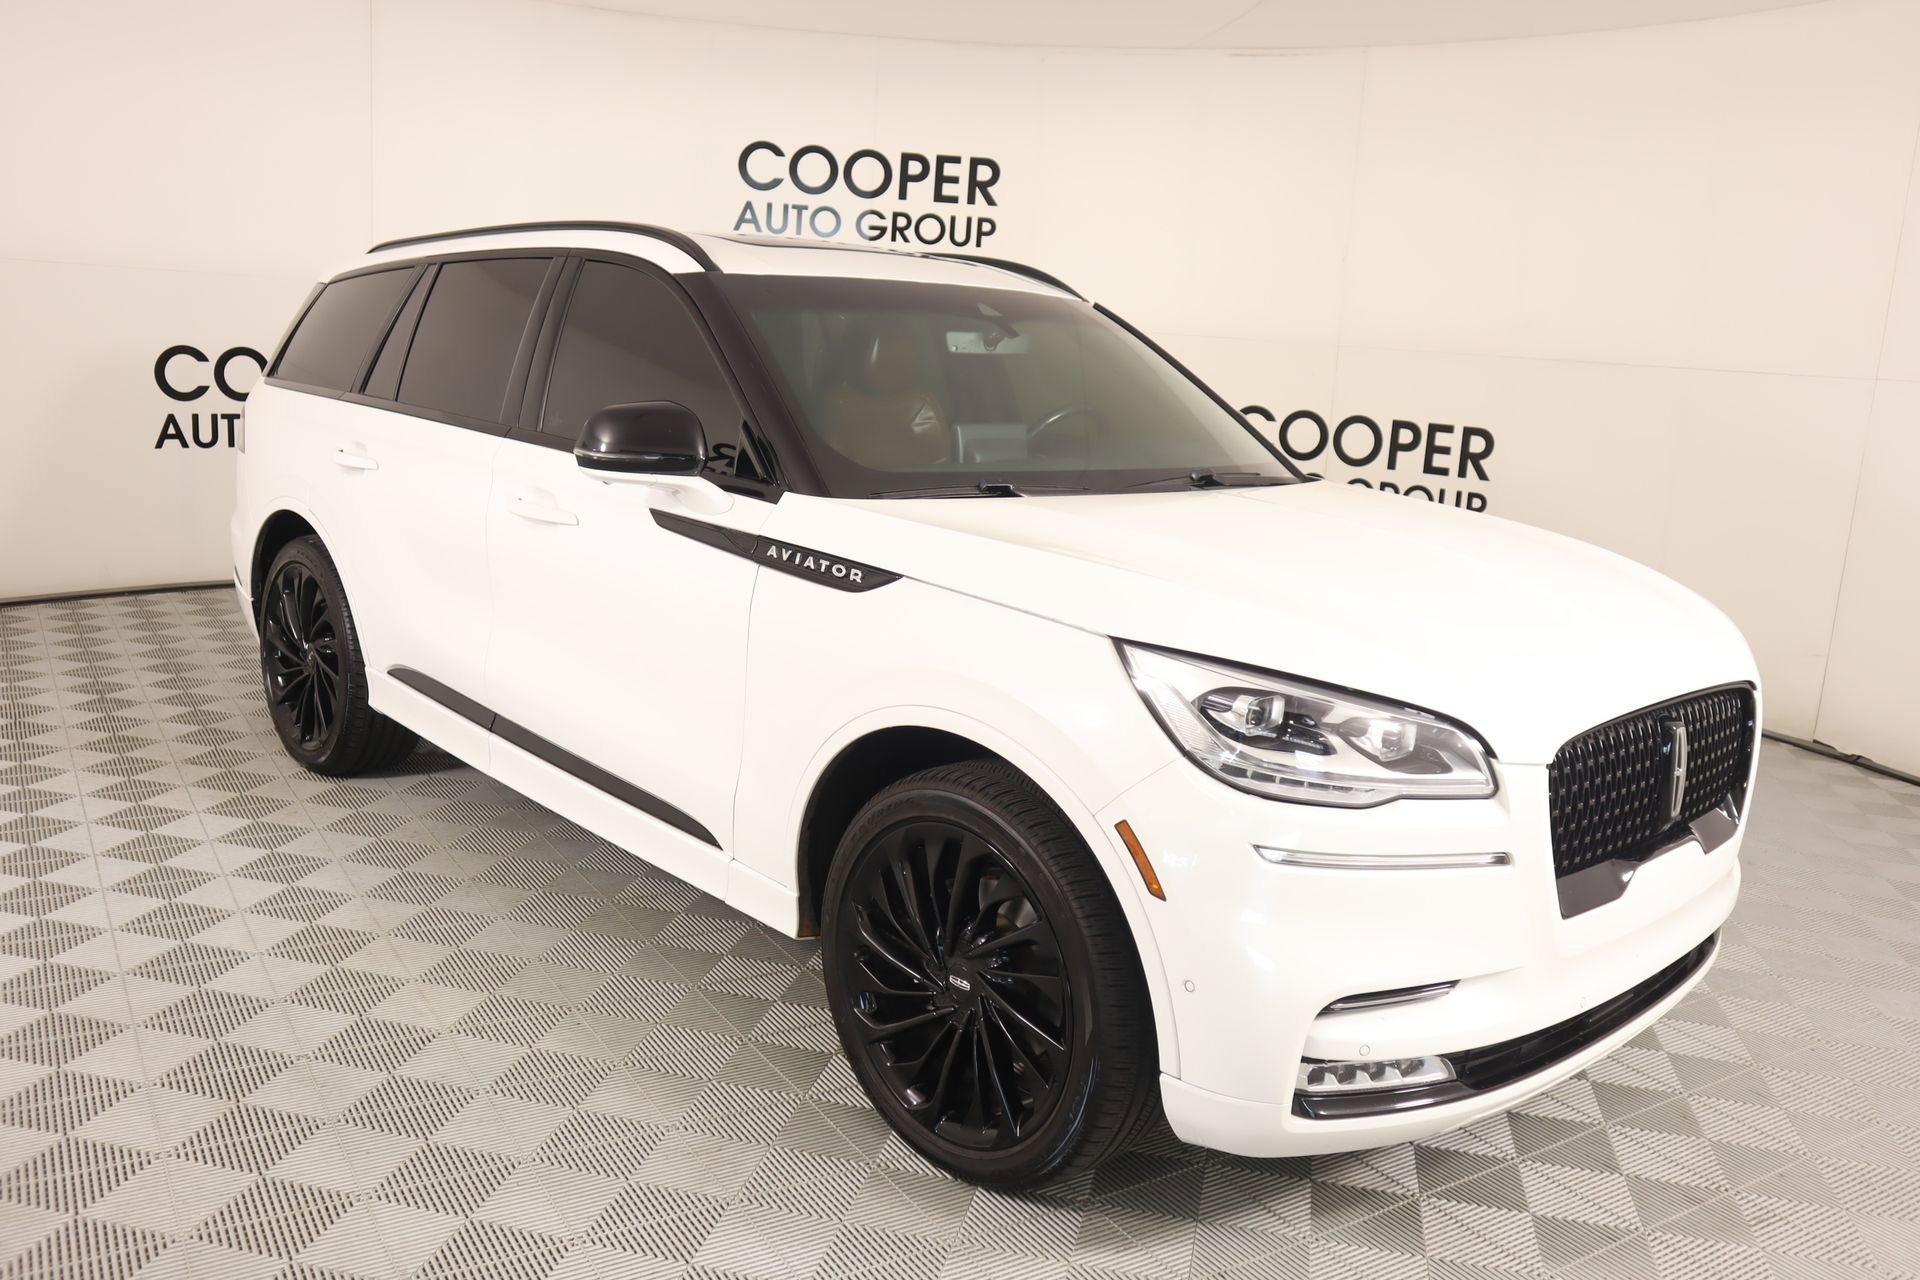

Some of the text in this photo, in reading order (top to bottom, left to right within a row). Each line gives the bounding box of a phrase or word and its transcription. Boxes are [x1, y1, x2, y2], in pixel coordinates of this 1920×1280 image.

[738, 140, 1001, 207] COOPER
[733, 200, 997, 248] AUTO GROUP
[154, 413, 241, 449] AUT
[766, 545, 863, 584] AVIATOR
